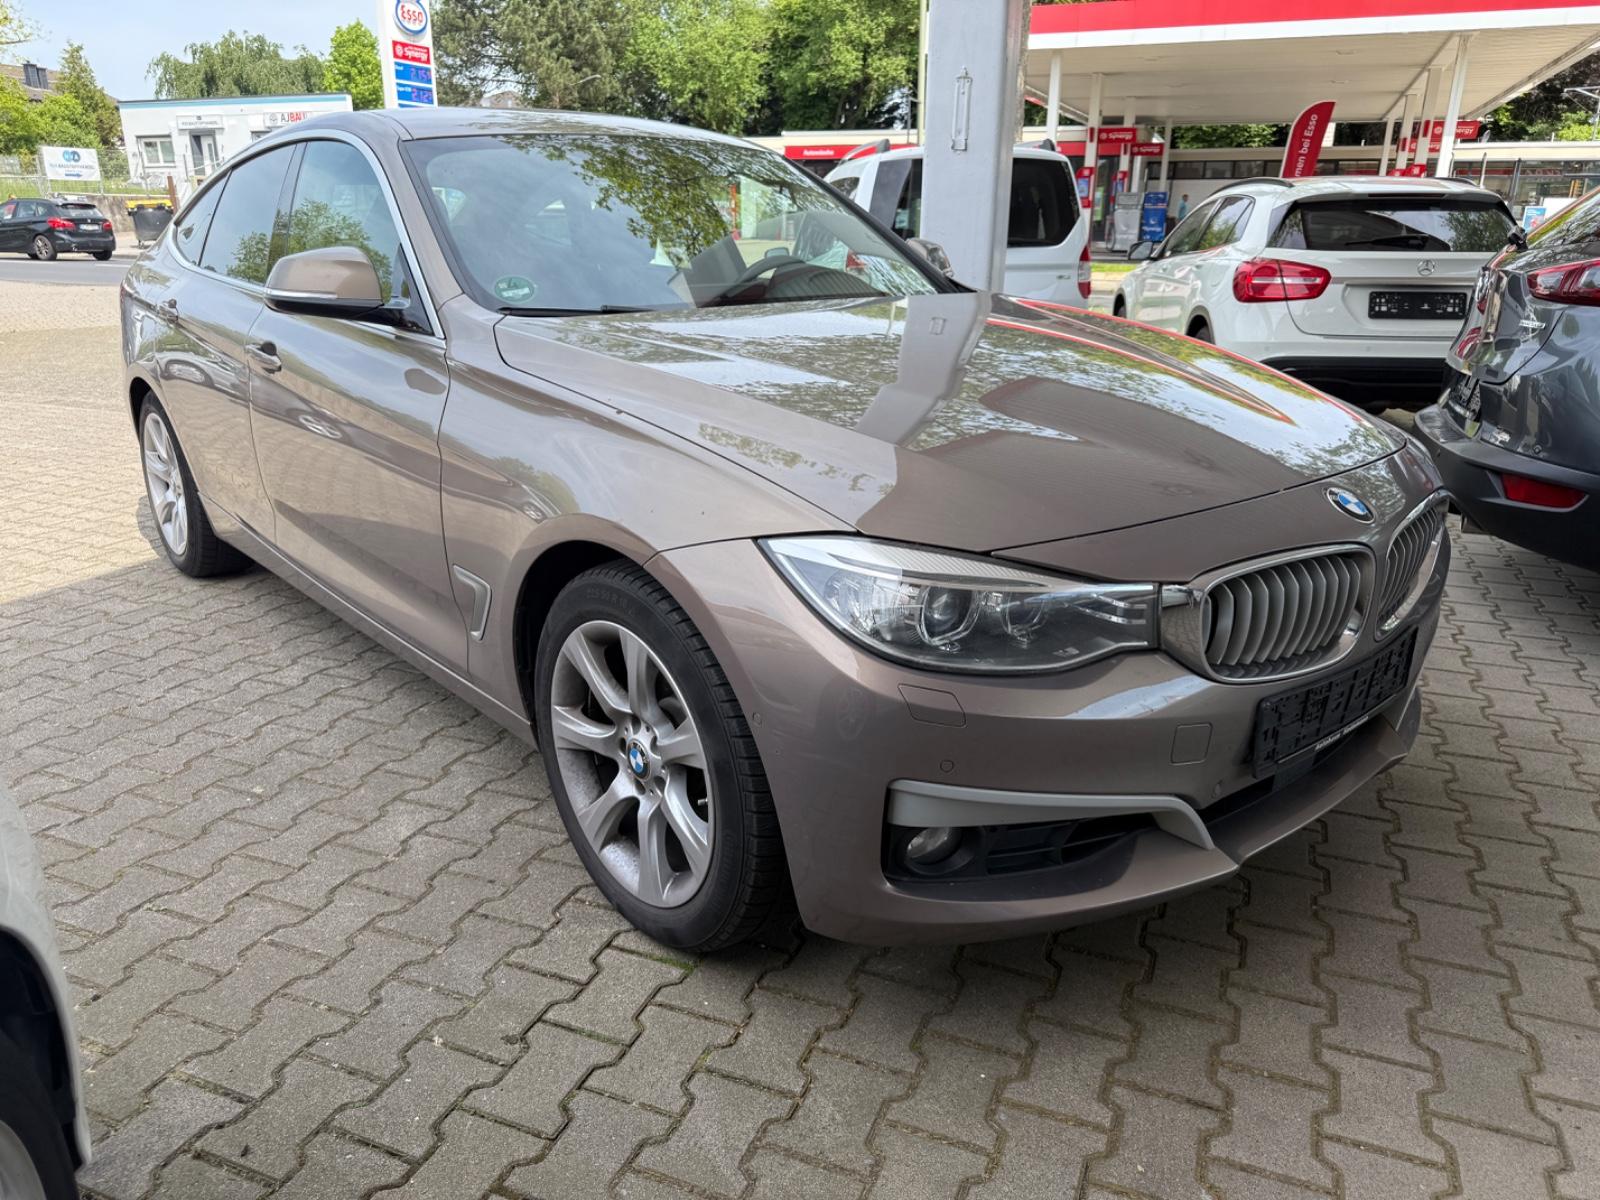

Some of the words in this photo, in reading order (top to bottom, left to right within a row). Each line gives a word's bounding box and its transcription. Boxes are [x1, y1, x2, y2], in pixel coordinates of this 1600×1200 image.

[404, 48, 428, 61] Synergy
[1303, 113, 1319, 137] Esso
[1108, 132, 1134, 140] Synergy
[1298, 138, 1312, 155] bei
